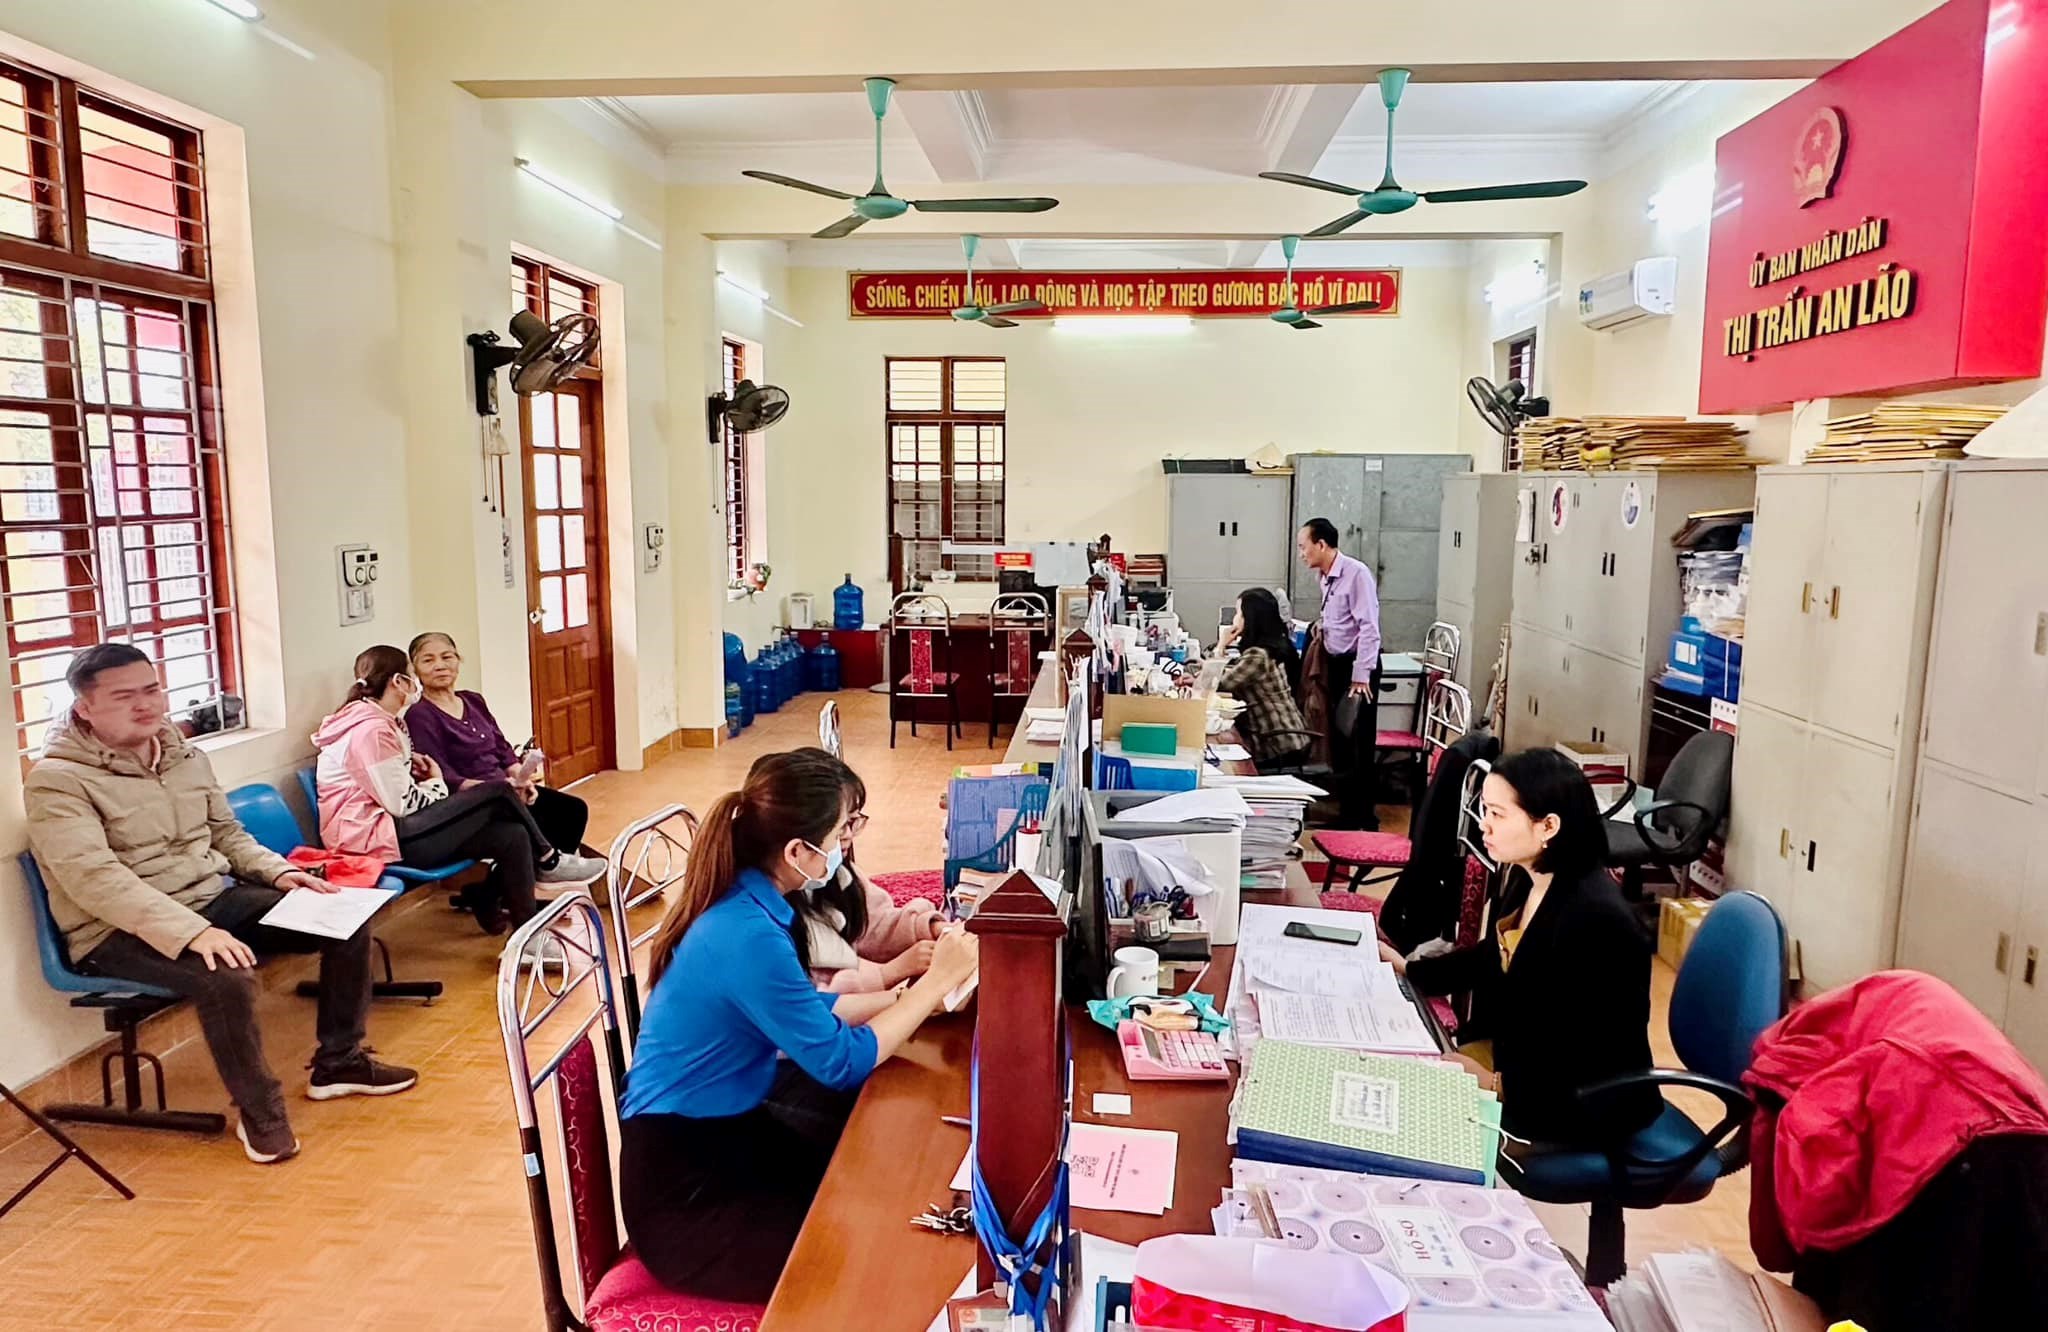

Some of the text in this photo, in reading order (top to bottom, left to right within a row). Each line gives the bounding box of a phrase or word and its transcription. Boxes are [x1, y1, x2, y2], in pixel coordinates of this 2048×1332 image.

[1768, 248, 1798, 283] BAN
[1800, 230, 1844, 272] NHÂN
[1846, 216, 1882, 257] DÂN
[915, 278, 960, 308] CHIẾN
[1035, 278, 1077, 312] ĐỘNG
[1080, 279, 1100, 307] VÀ
[1103, 283, 1134, 312] HỌC
[1138, 278, 1166, 312] TẬP
[1170, 283, 1208, 307] THEO
[1212, 280, 1264, 306] GƯƠNG
[1303, 275, 1325, 305] HỒ
[1328, 278, 1344, 305] VĨ
[1723, 262, 1911, 362] THỊ TRẤN AN LÃO
